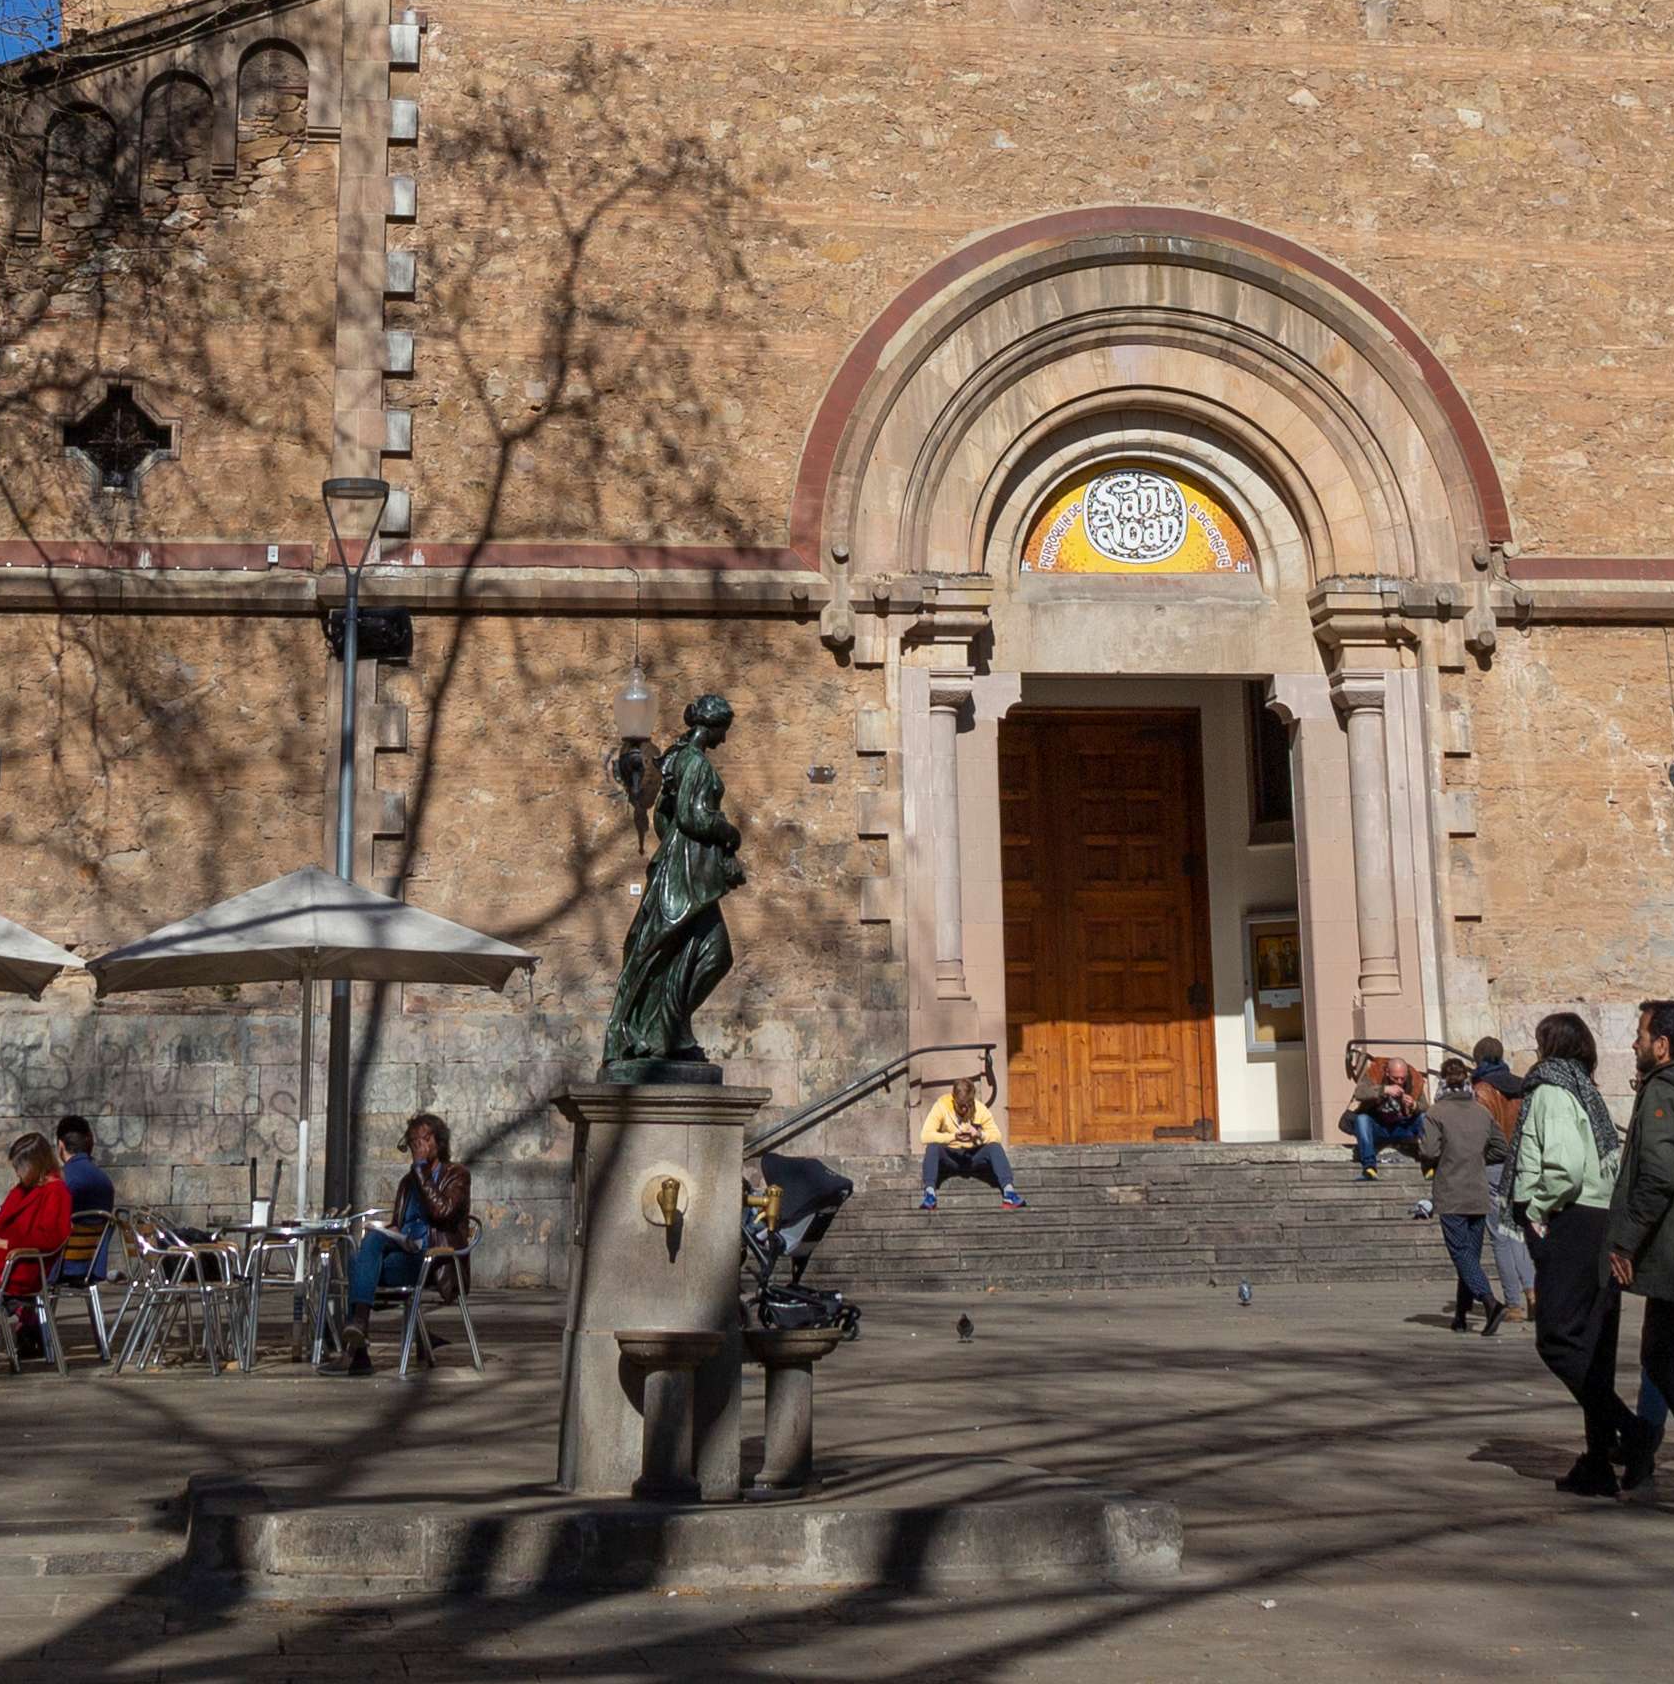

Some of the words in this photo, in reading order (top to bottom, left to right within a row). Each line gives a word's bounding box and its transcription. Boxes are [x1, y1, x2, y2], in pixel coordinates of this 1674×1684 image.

[1096, 475, 1176, 519] Sant
[1039, 514, 1074, 568] PARROQUIA
[1068, 503, 1082, 518] DE
[1092, 503, 1179, 556] Joan
